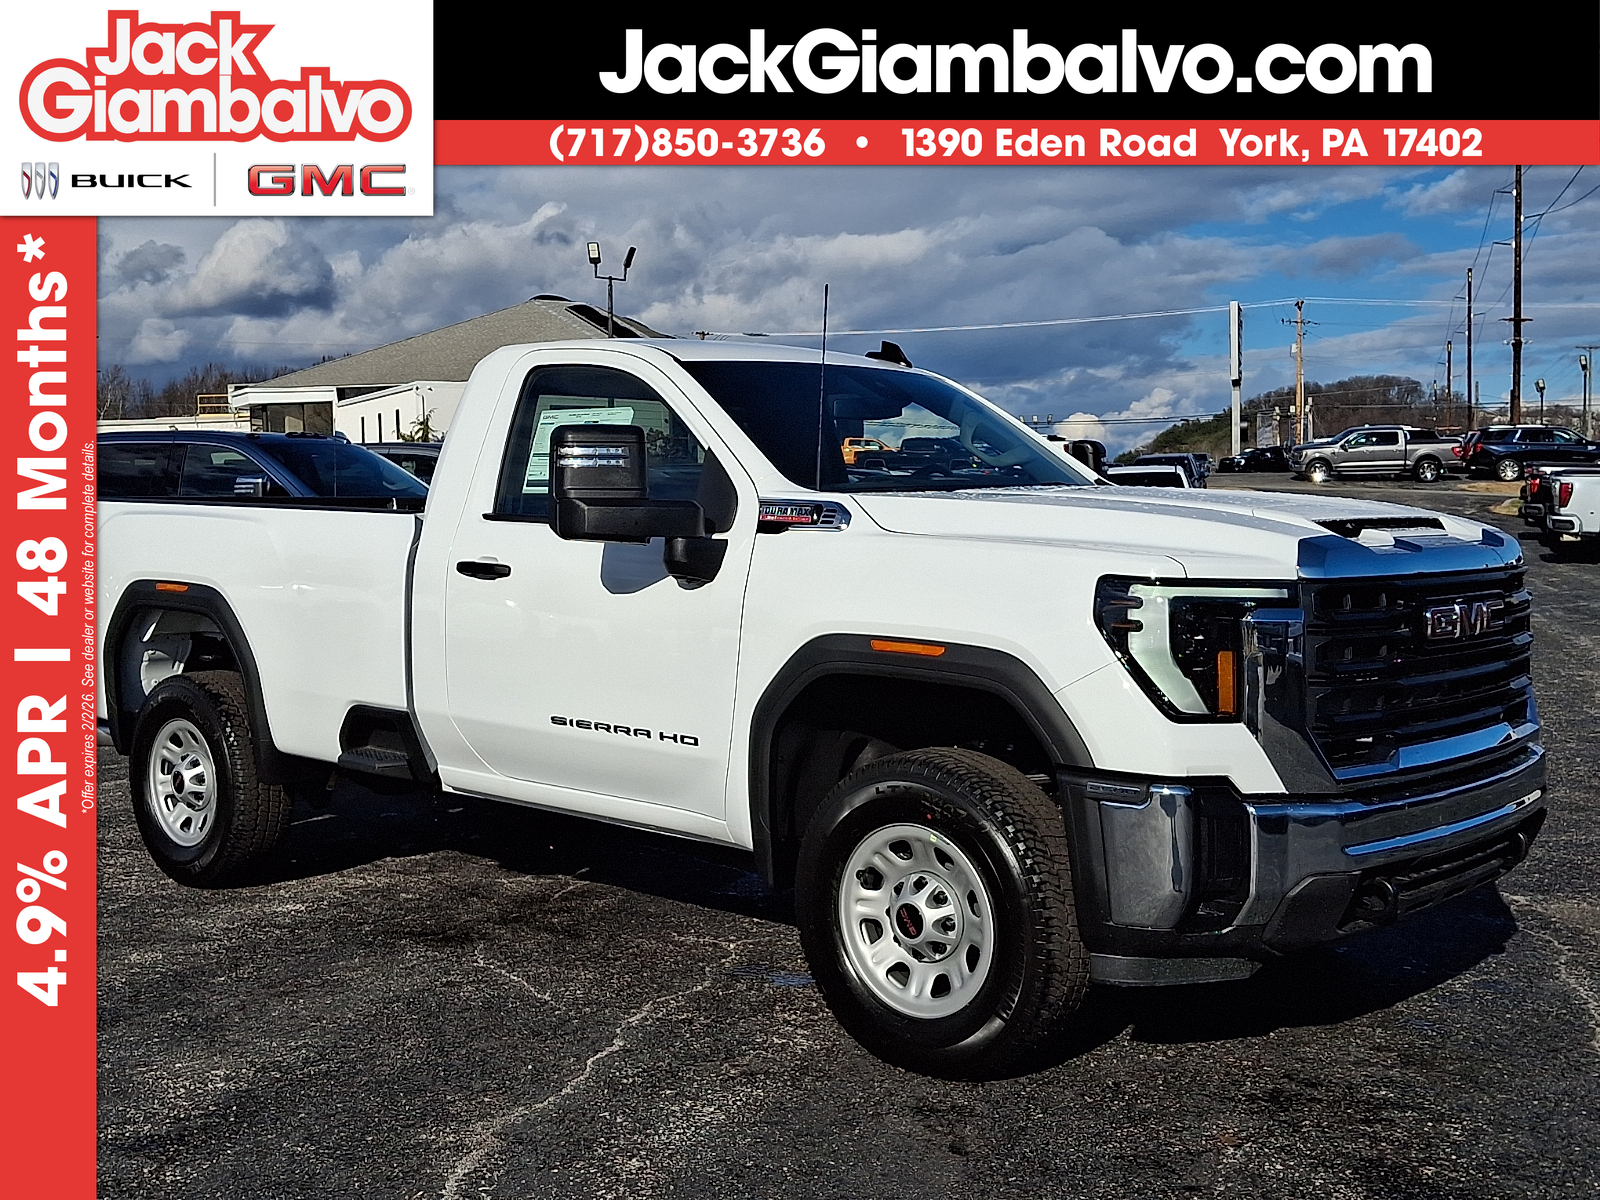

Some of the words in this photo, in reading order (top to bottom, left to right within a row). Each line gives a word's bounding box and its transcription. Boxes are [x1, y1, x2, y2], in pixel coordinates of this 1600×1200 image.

[763, 506, 810, 516] DURAMAX
[1427, 600, 1504, 639] GMC
[550, 715, 652, 739] SIERRA
[659, 731, 700, 746] HD
